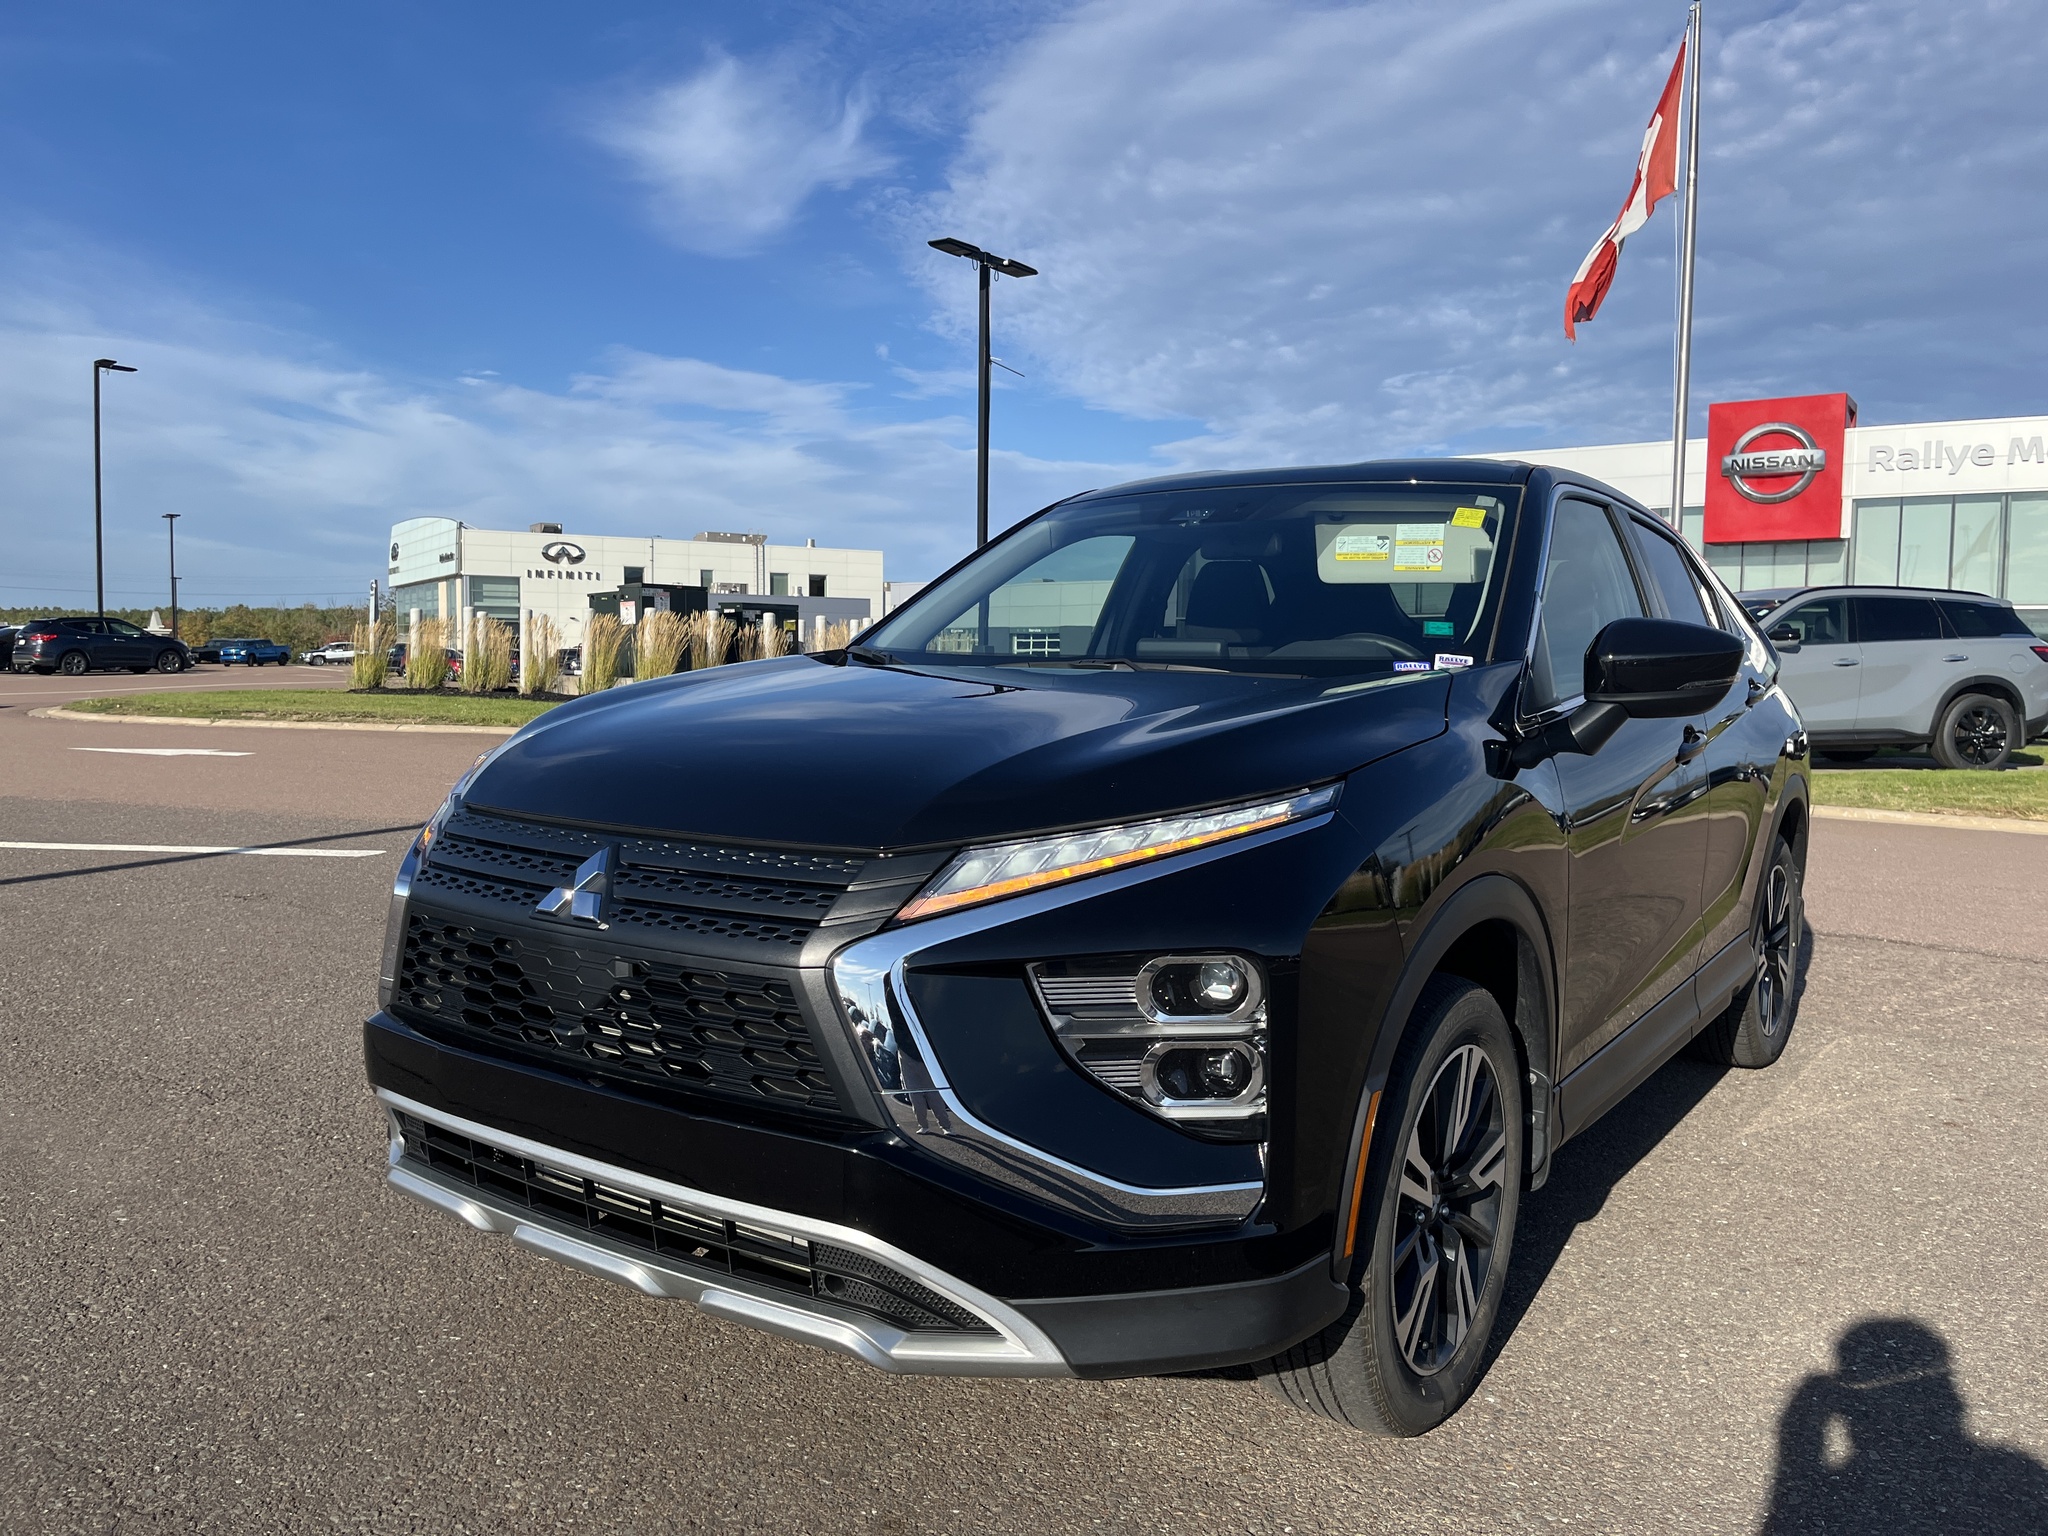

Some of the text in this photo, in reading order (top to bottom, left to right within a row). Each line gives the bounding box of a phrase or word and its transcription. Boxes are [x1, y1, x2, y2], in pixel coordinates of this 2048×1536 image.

[1730, 454, 1814, 471] NISSAN
[1868, 436, 2048, 475] Rallye M
[527, 569, 600, 581] INFINITI
[1439, 655, 1469, 664] RALLYE
